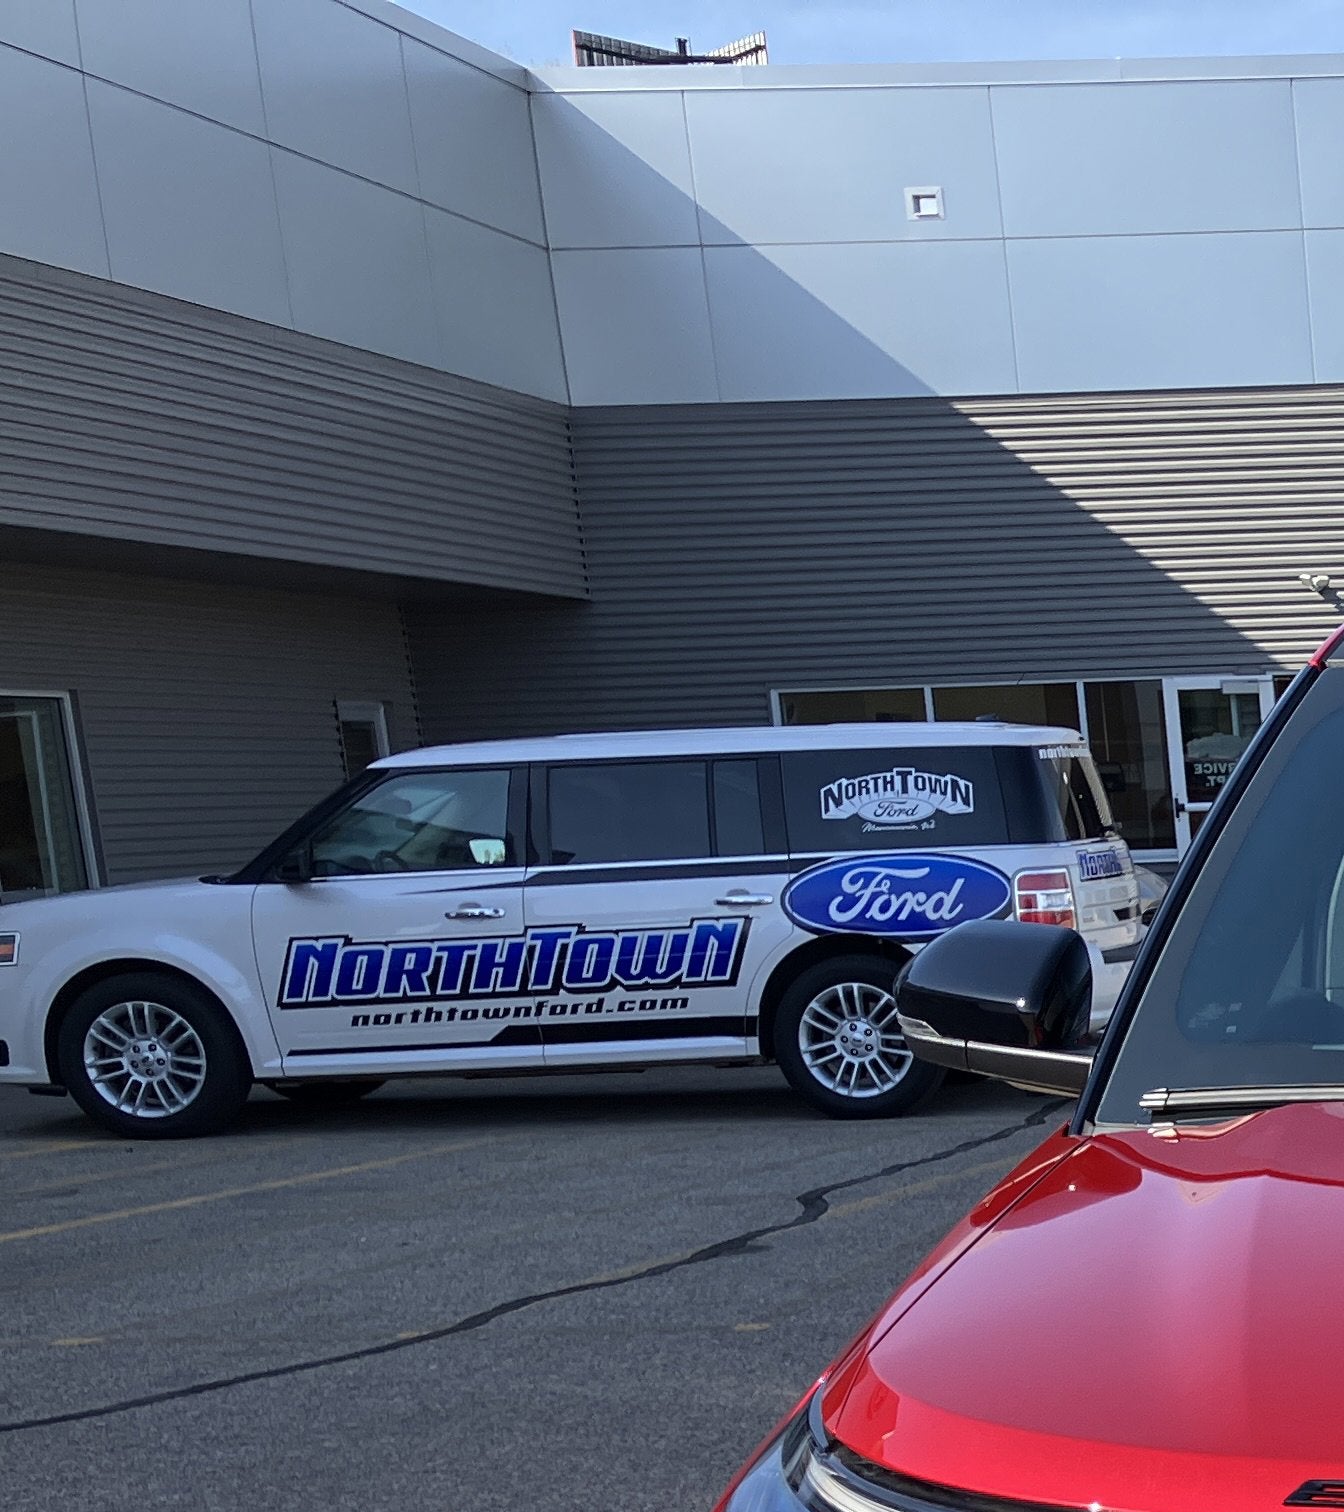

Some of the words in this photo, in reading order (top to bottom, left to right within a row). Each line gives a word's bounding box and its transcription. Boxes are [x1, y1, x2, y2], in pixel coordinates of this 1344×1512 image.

[873, 801, 920, 818] Ford
[828, 866, 966, 923] Ford
[282, 917, 749, 1006] NORTHTOWN
[350, 997, 690, 1028] northtownford.com
